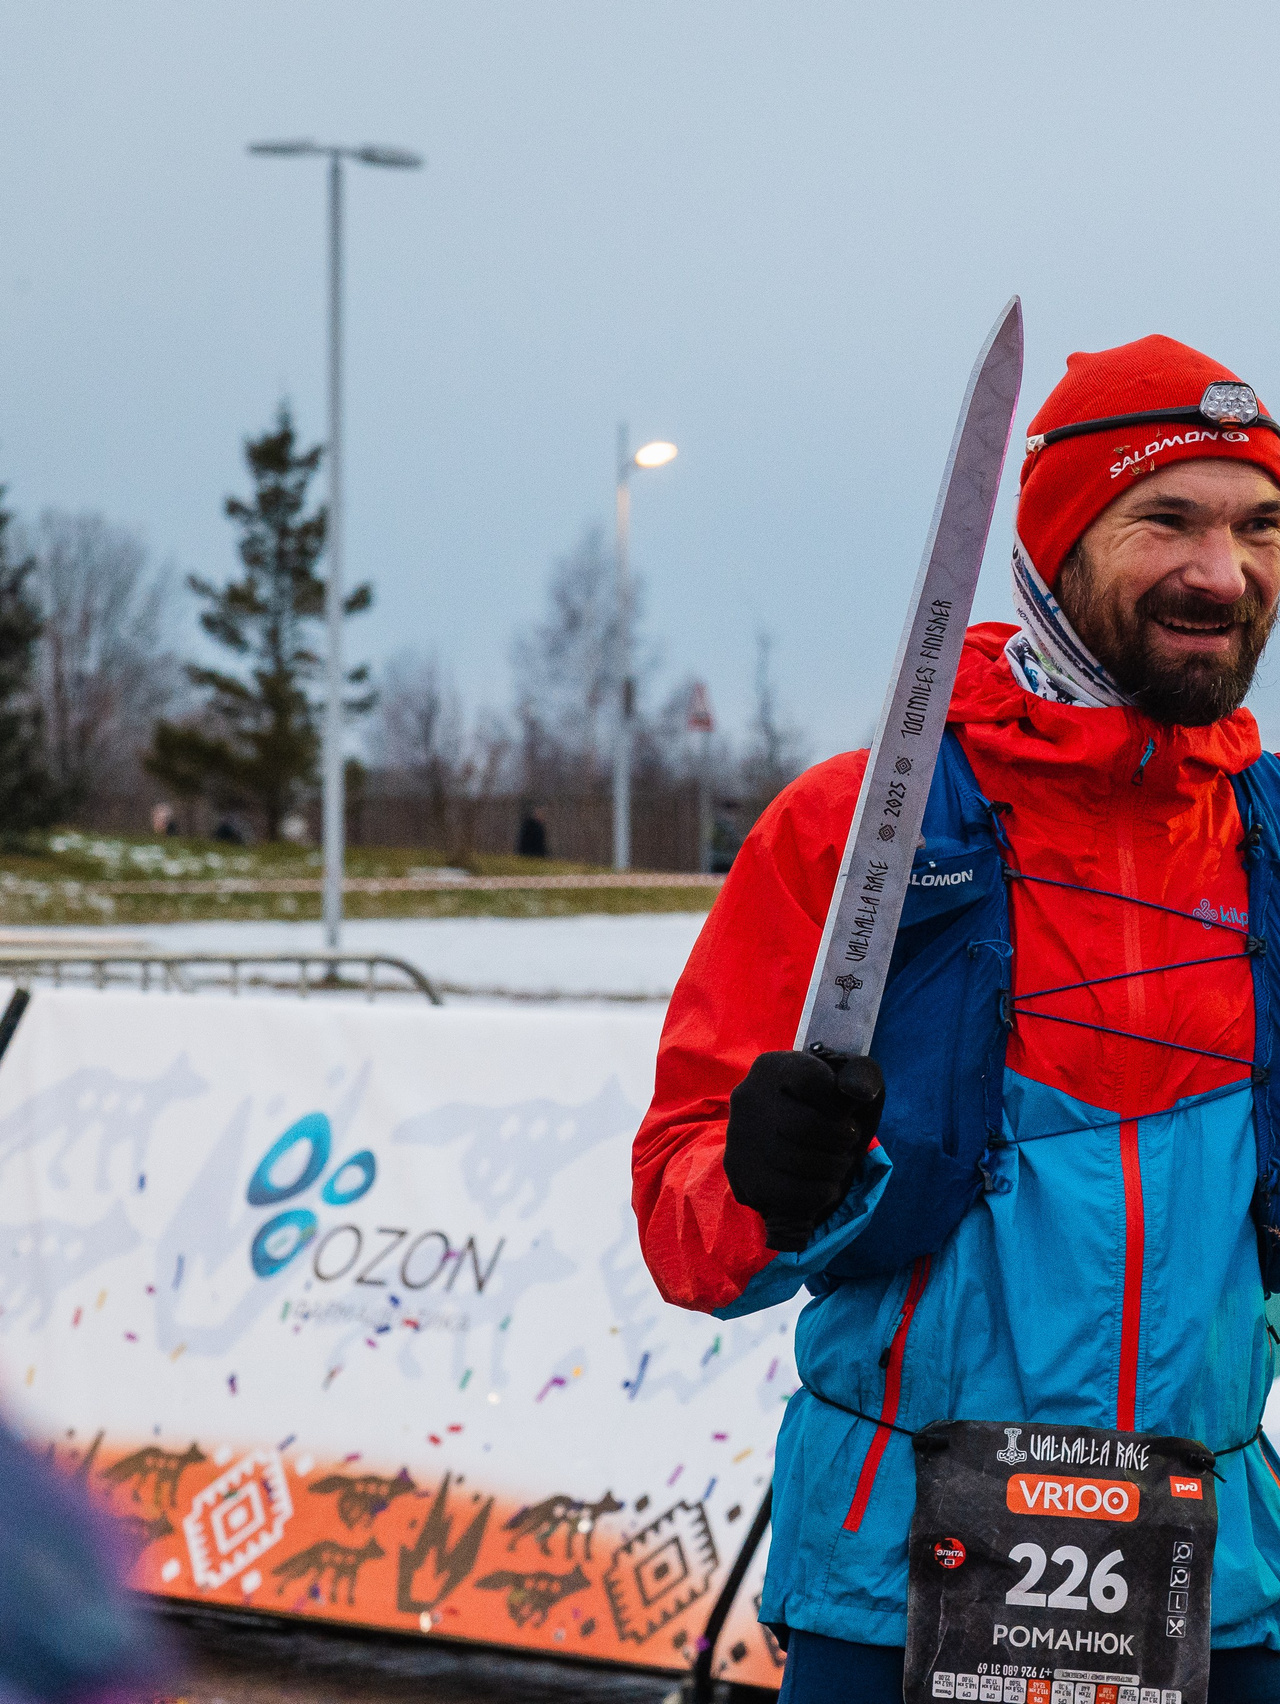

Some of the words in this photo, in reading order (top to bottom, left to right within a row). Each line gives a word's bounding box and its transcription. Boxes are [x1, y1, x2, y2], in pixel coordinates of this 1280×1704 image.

[1109, 430, 1219, 479] SALOMON
[920, 599, 952, 660] FINISHER
[884, 781, 907, 818] 2025
[863, 860, 889, 892] RACE
[909, 869, 973, 887] LOMON
[1220, 905, 1249, 927] kilp
[313, 1223, 506, 1294] OZON
[1115, 1441, 1150, 1471] RACE
[1019, 1480, 1129, 1515] VR100
[936, 1549, 964, 1558] ЭЛИТА
[1005, 1542, 1129, 1614] 226
[992, 1623, 1135, 1656] РОМАНЮК
[977, 1662, 988, 1674] 69
[991, 1663, 1001, 1675] 31
[1003, 1664, 1019, 1676] 680
[1021, 1666, 1037, 1678] 926
[1039, 1667, 1052, 1678] +7
